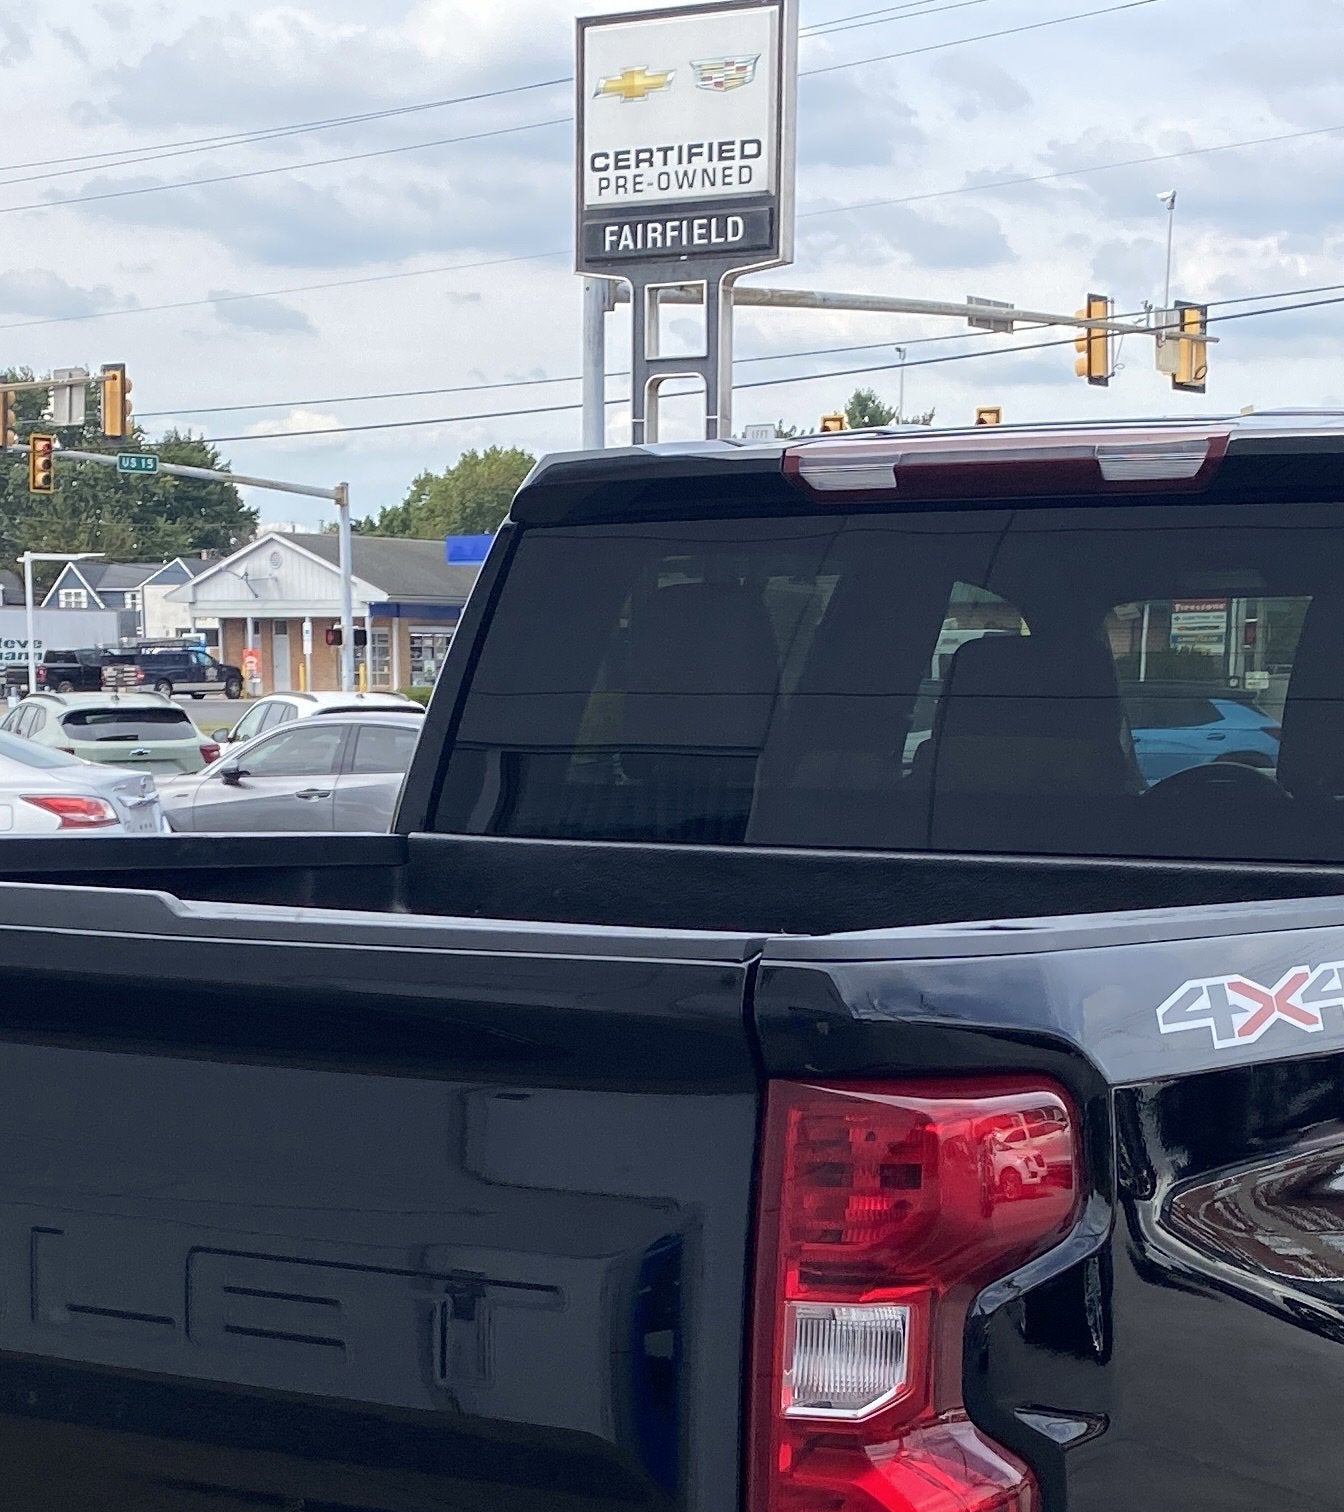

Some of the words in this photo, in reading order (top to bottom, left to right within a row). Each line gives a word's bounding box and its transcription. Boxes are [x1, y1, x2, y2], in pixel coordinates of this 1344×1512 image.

[590, 138, 763, 173] CERTIFIED
[598, 164, 754, 197] PRE-OWNED
[604, 215, 745, 252] FAIRFIELD
[121, 457, 137, 468] US
[141, 458, 154, 469] 15
